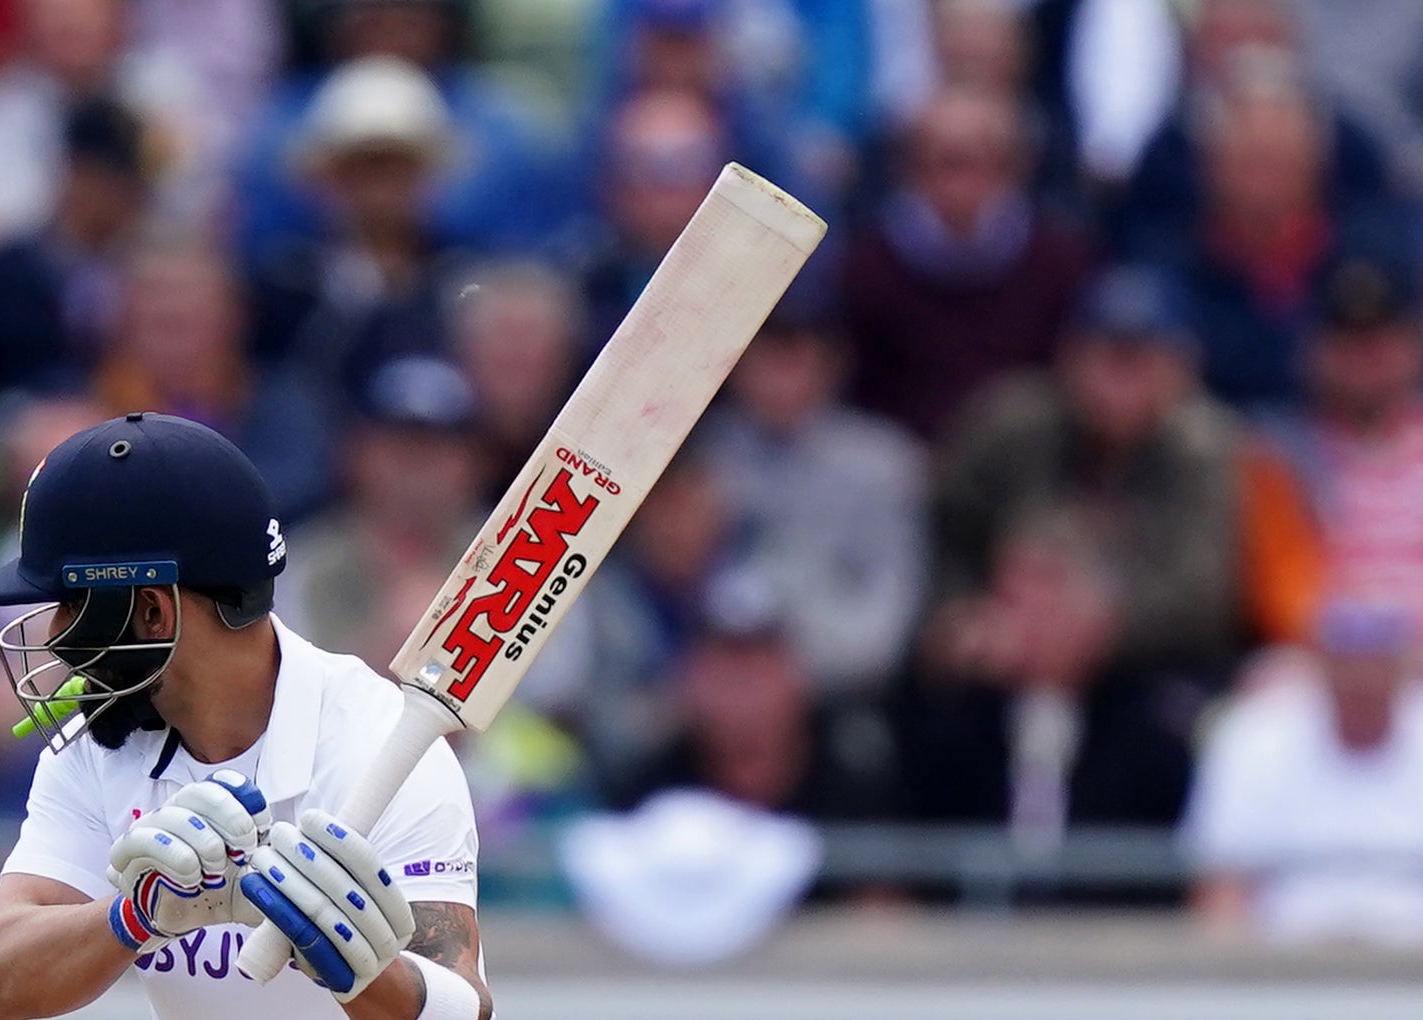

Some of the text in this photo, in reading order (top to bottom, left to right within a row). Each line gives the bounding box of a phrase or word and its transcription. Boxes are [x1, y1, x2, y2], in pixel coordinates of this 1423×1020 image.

[556, 447, 621, 495] GRAND
[84, 566, 138, 581] SHREY
[442, 467, 599, 702] MRF
[504, 553, 587, 662] Genius
